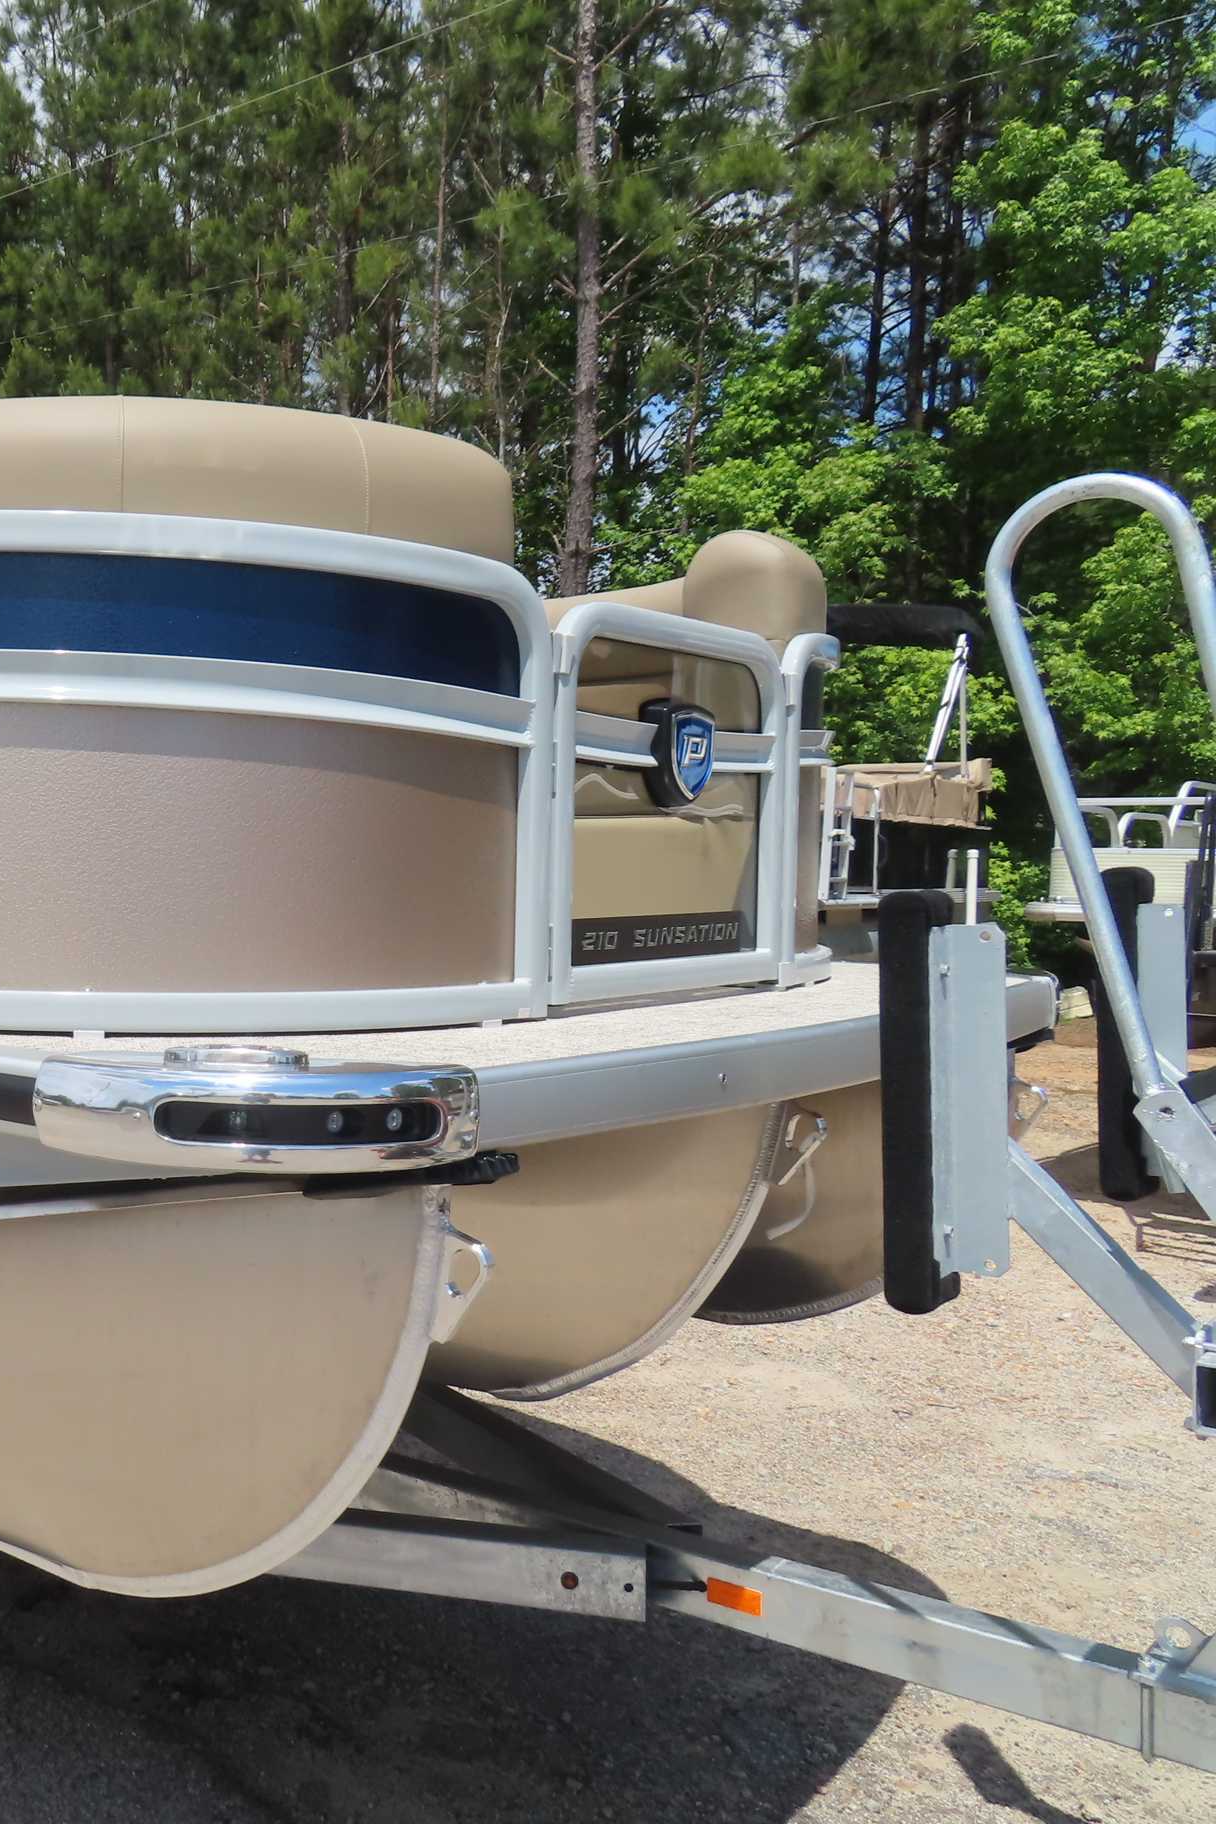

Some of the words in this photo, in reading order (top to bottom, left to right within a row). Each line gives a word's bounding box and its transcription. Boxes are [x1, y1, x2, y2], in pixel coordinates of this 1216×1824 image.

[681, 735, 707, 767] P
[582, 931, 618, 951] 210
[633, 922, 739, 948] SUNSATION
